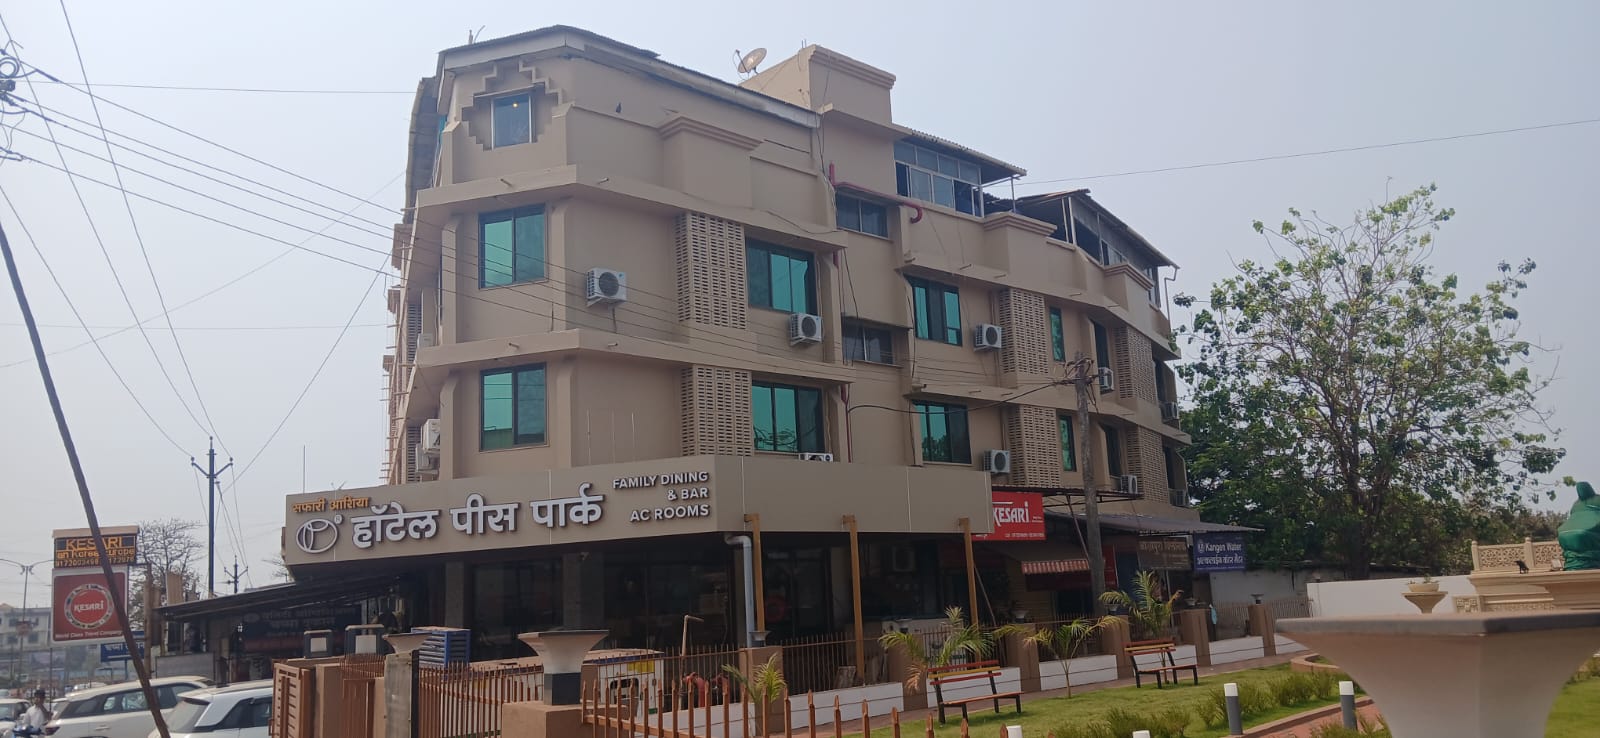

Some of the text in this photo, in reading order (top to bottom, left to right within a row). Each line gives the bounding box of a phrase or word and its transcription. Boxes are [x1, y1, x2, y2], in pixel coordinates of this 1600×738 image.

[612, 471, 708, 489] FAMILY DINING
[667, 487, 708, 501] & BAR
[292, 496, 370, 513] सफारी आशिया
[630, 504, 709, 522] AC ROOMS
[350, 482, 604, 549] हॉटेल पीस पार्क
